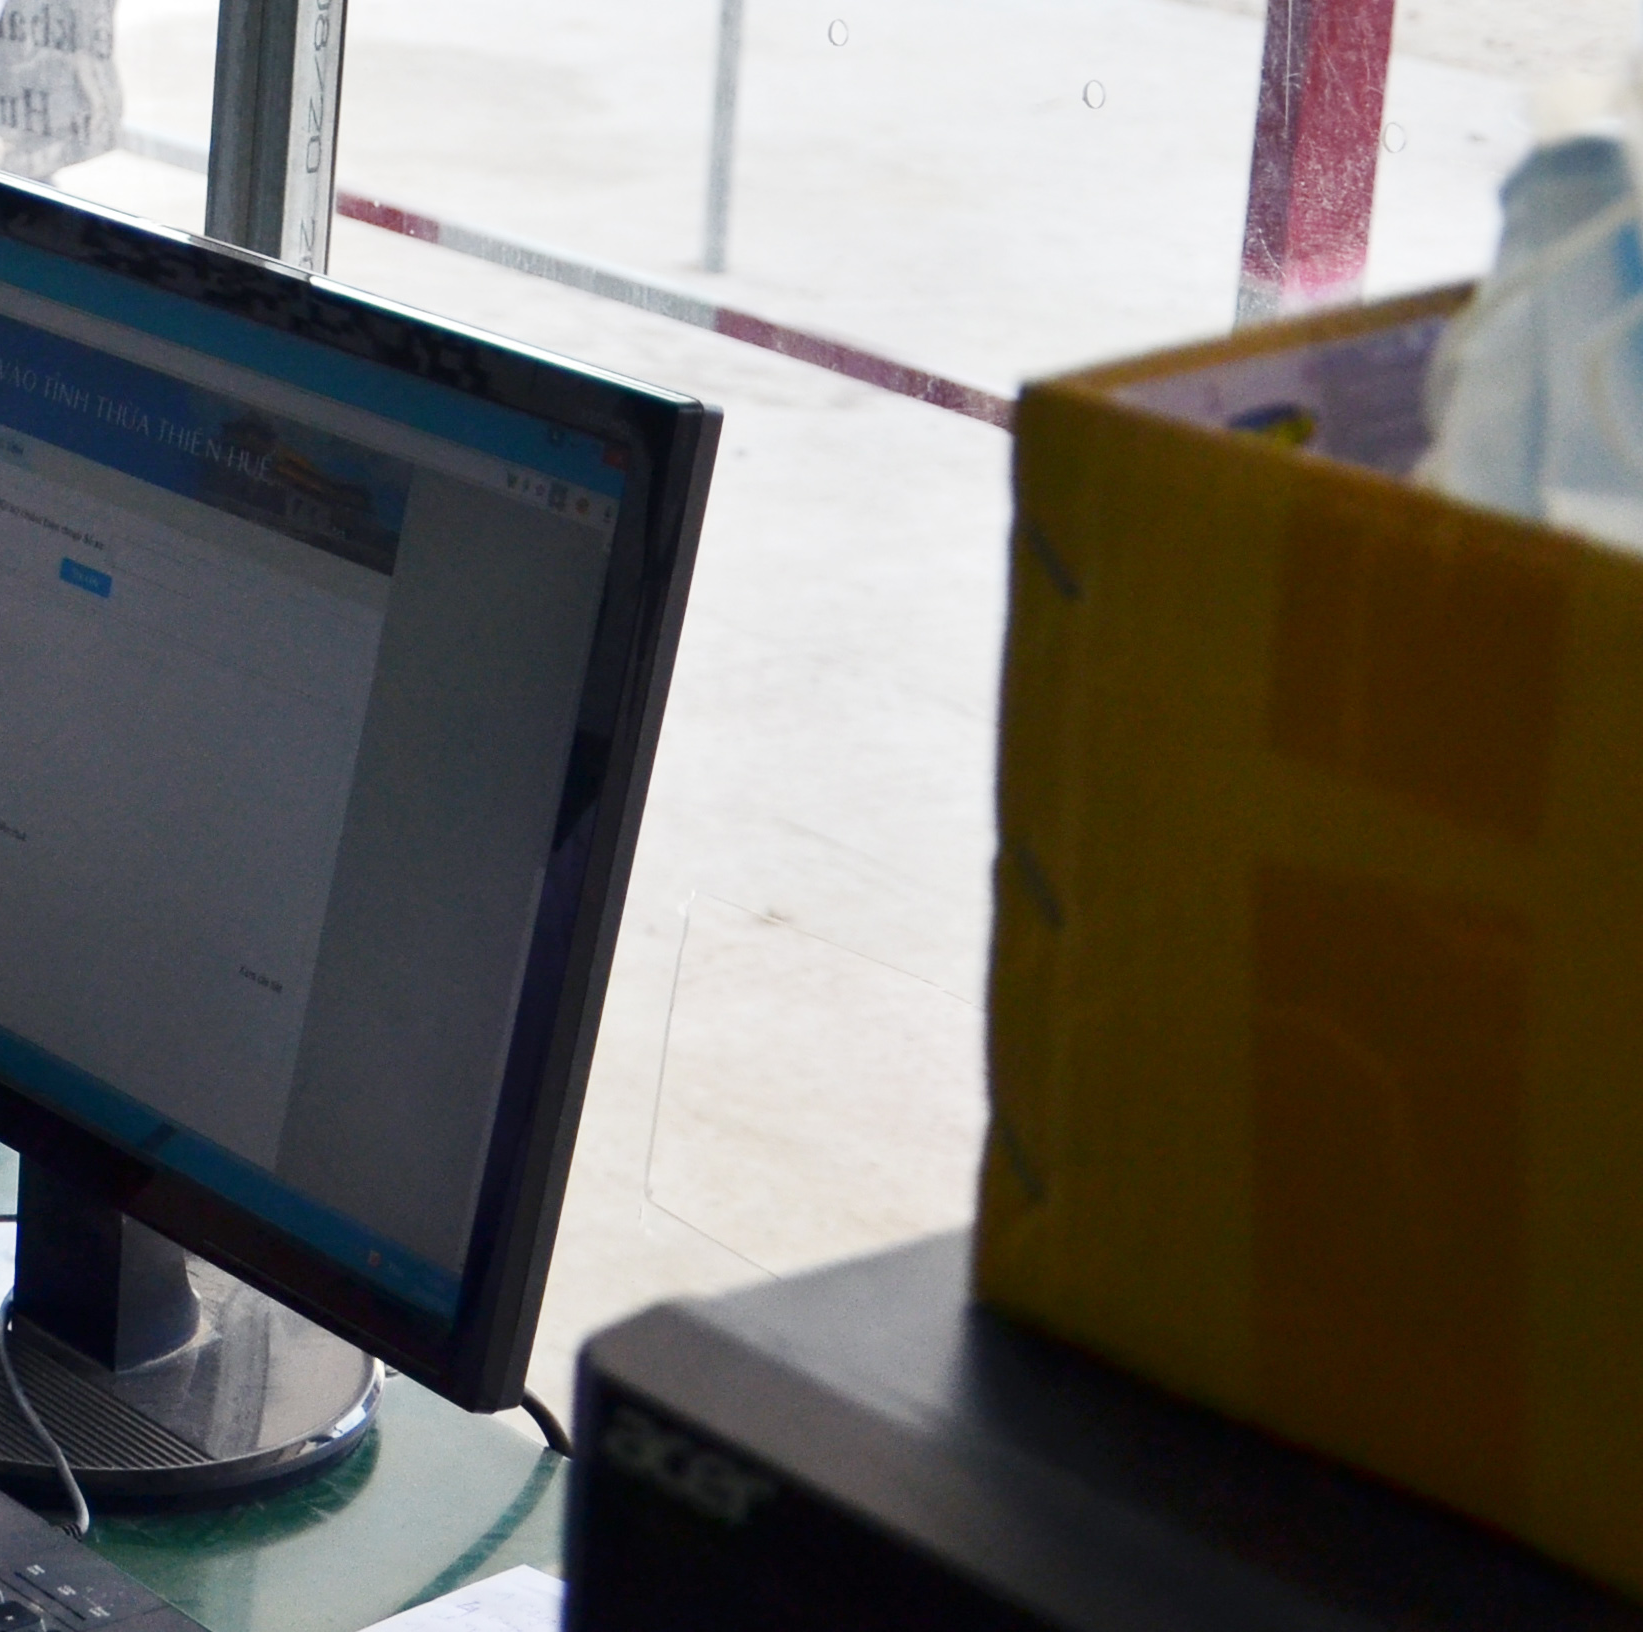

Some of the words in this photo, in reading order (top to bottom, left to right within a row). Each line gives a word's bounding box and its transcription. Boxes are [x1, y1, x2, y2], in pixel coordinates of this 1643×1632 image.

[42, 363, 93, 414] TỈNH
[94, 387, 153, 437] THỪA
[156, 408, 232, 467] THIÊN
[226, 433, 274, 484] HUẾ
[603, 1403, 779, 1528] acer
